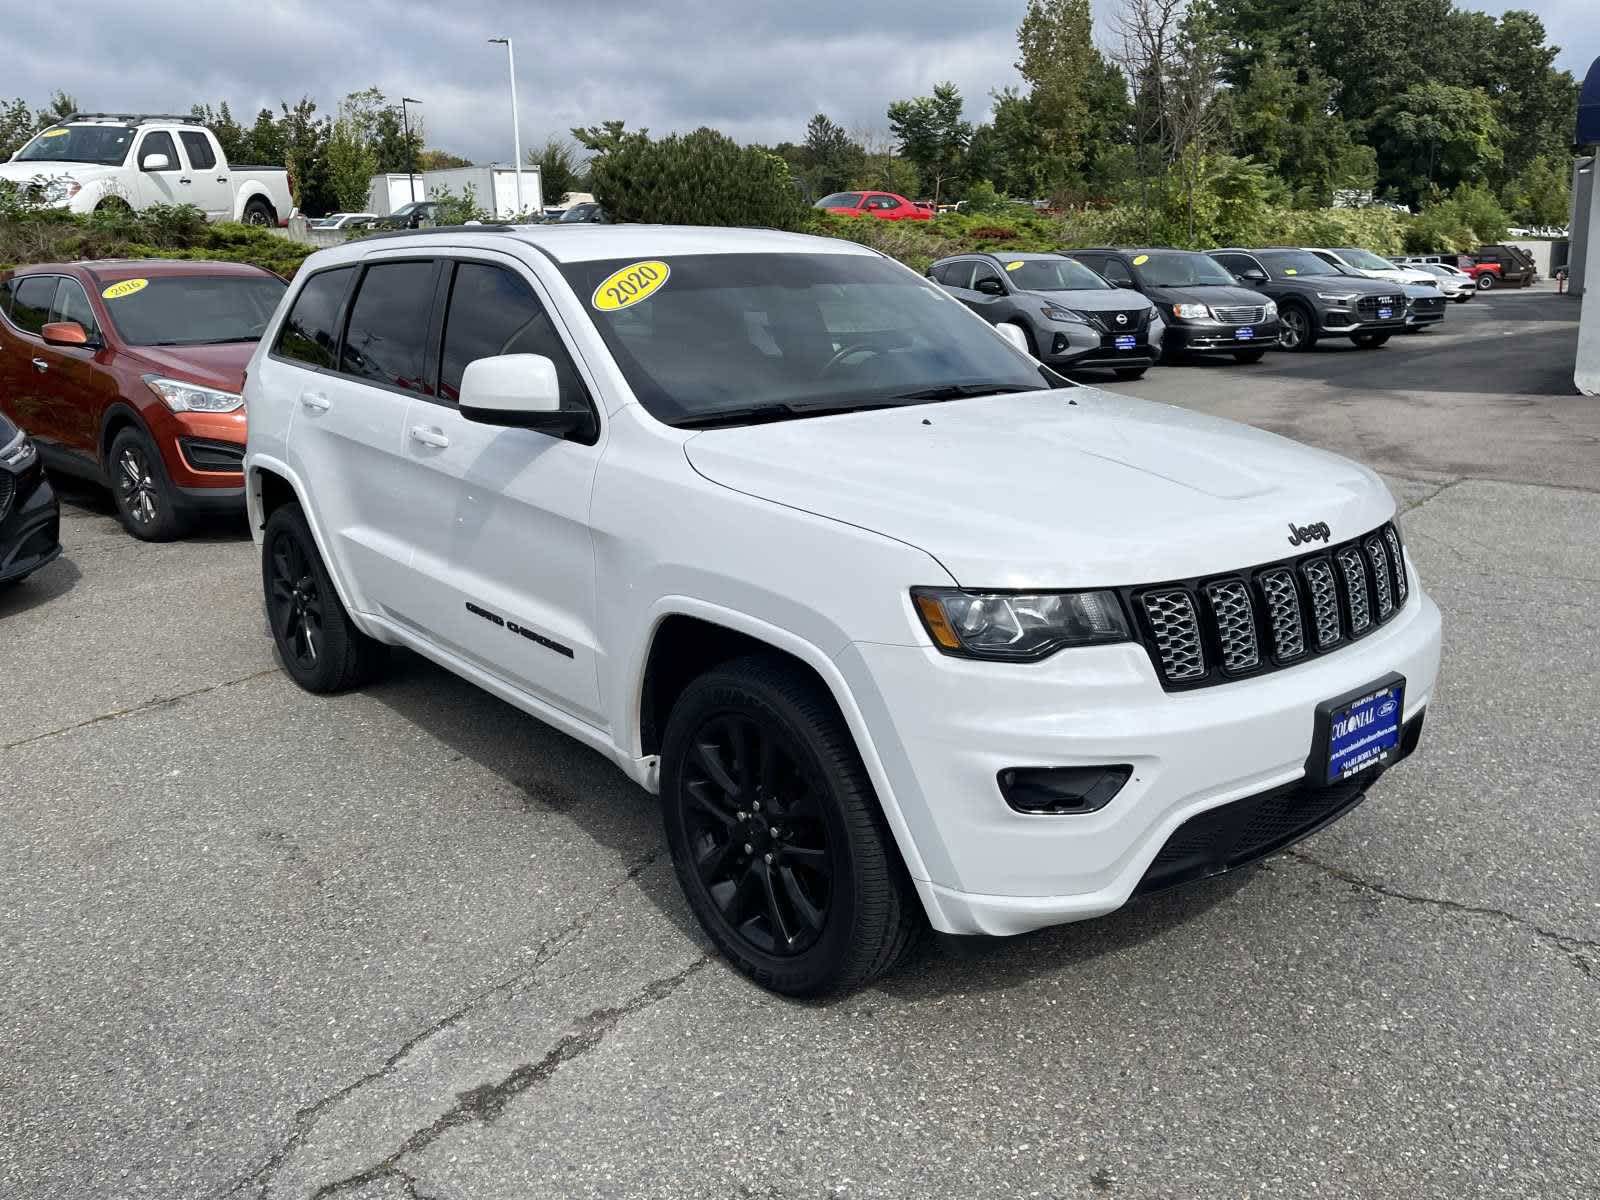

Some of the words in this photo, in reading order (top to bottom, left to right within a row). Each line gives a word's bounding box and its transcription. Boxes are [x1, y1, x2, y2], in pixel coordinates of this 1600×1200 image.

[110, 280, 142, 296] 2016
[606, 266, 659, 305] 2020
[1287, 521, 1331, 546] Jeep
[1331, 707, 1375, 741] COLONIAL
